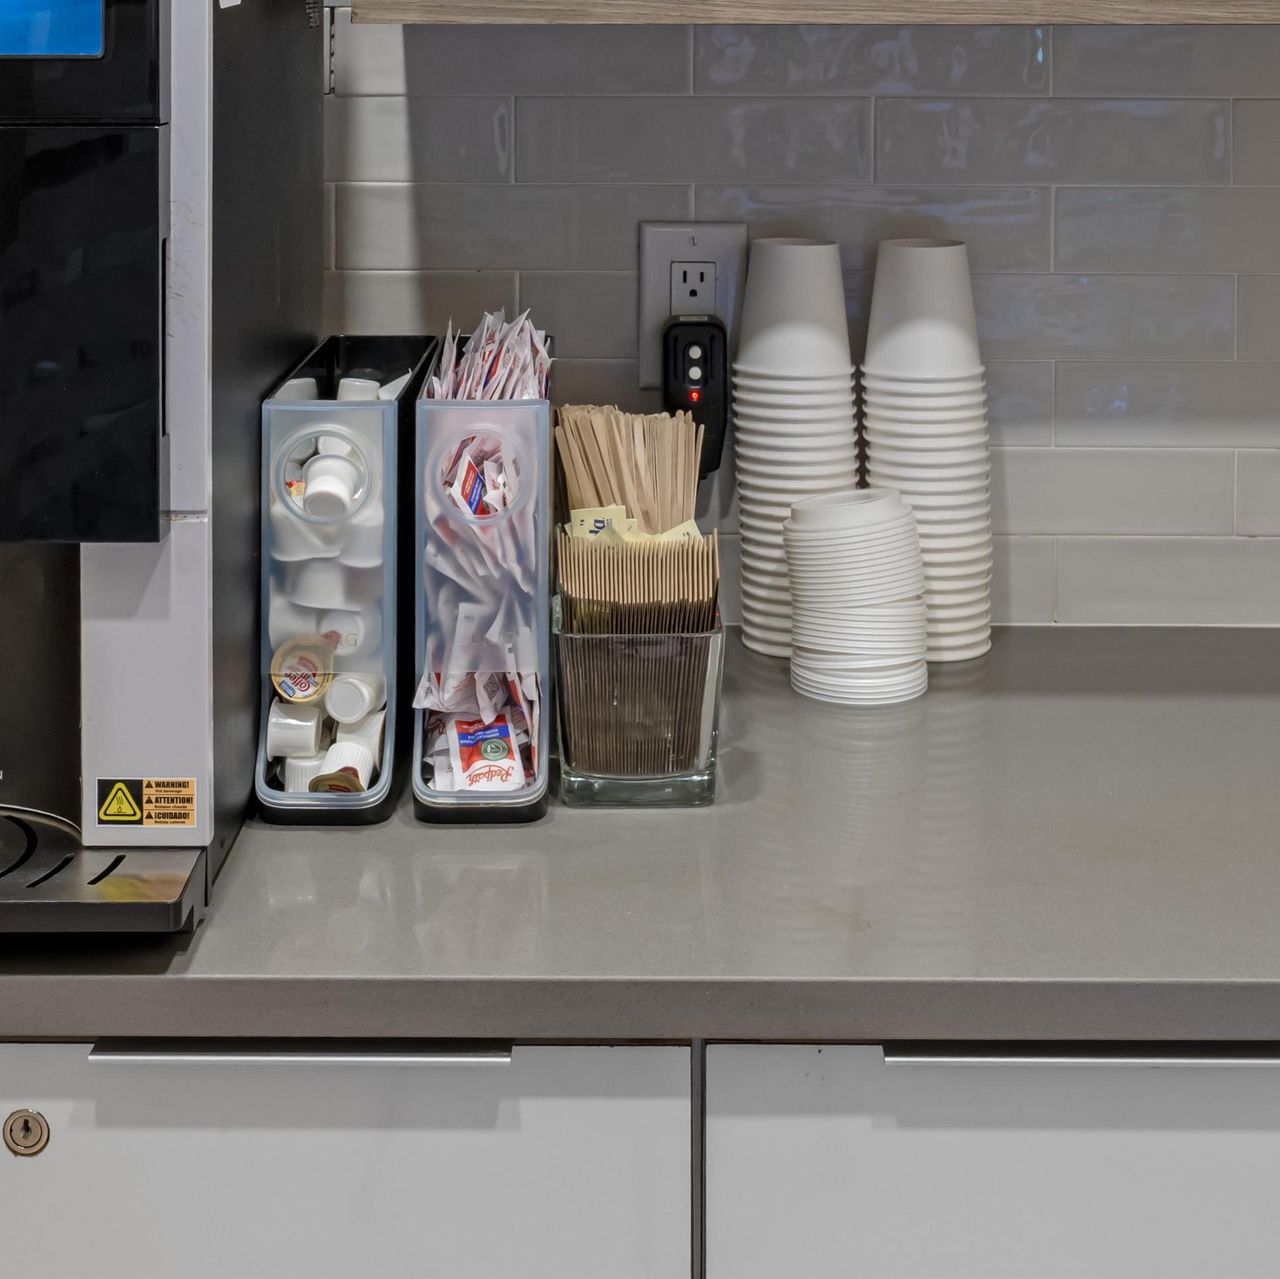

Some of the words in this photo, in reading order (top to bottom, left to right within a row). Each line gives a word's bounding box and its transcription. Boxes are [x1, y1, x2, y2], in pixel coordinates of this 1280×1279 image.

[467, 764, 515, 788] Redpath
[154, 781, 190, 789] WARNING!
[154, 796, 194, 804] ATTENTION!
